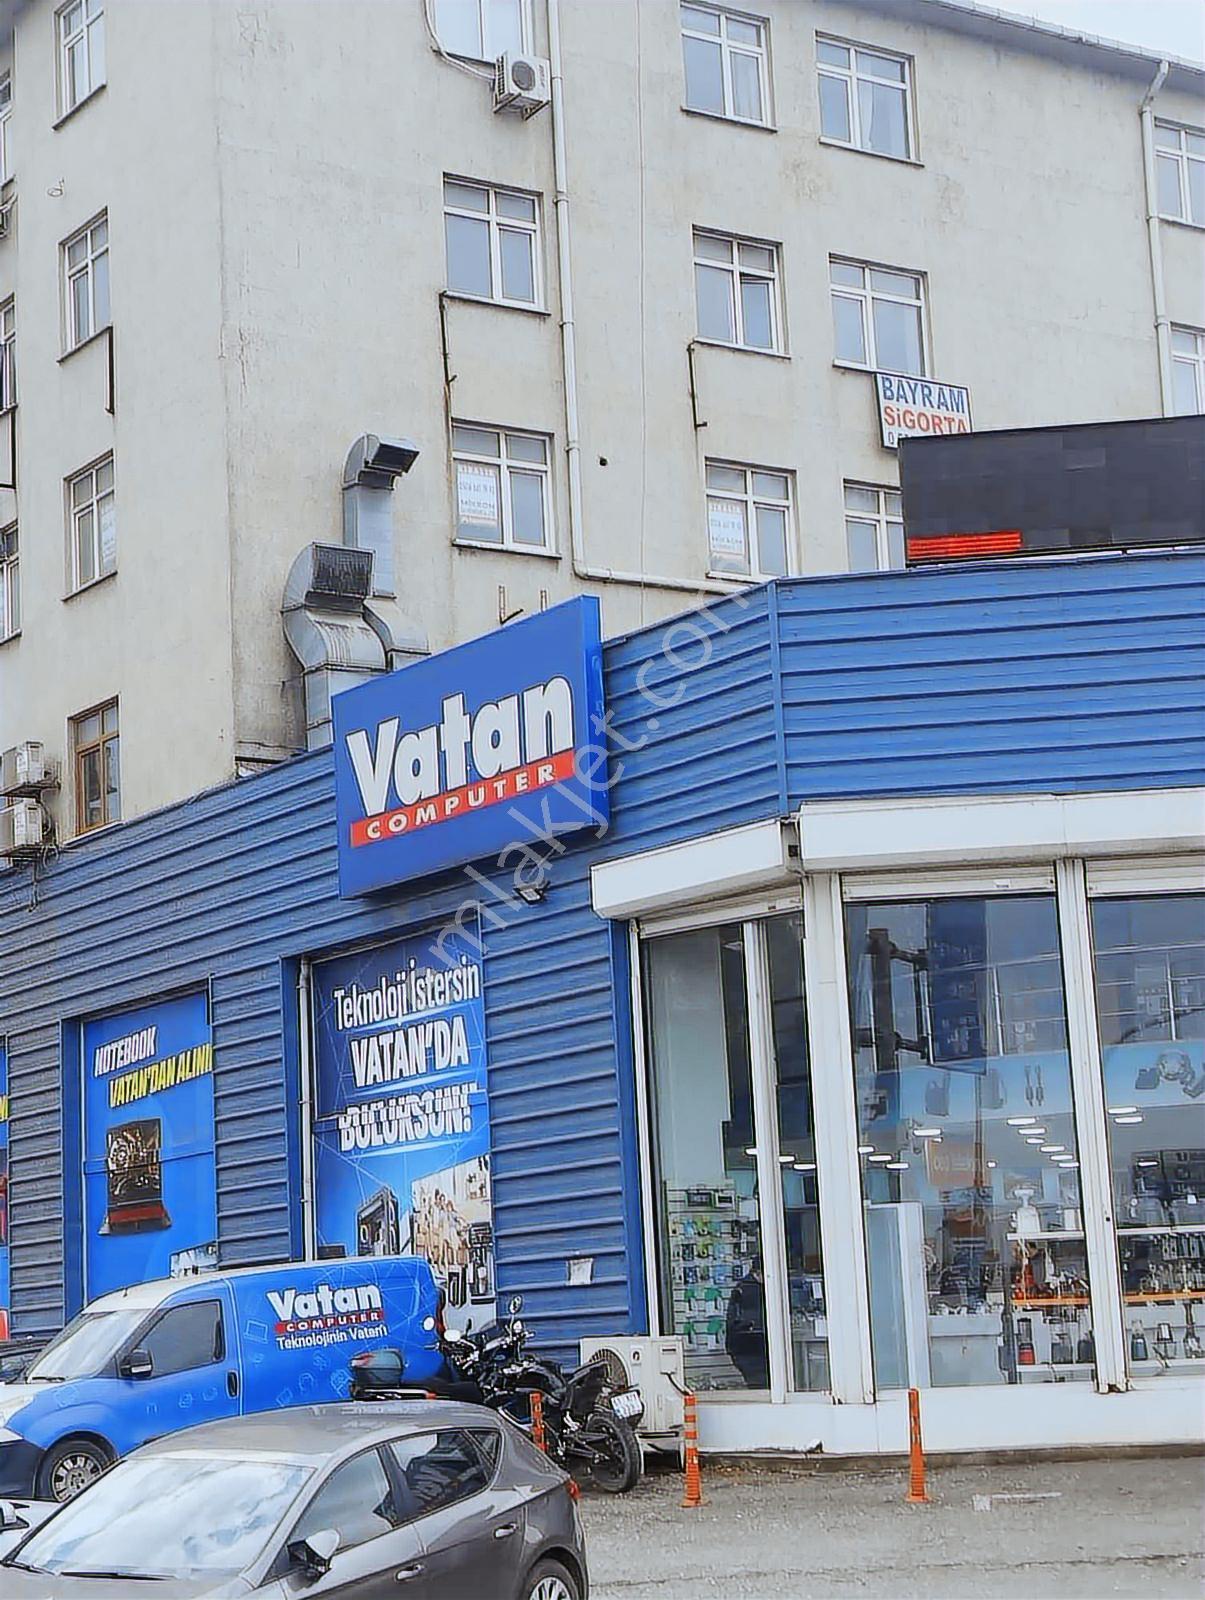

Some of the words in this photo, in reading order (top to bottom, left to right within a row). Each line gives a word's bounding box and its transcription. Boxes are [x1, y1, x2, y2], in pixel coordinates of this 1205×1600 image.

[881, 376, 965, 413] BAYRAM
[346, 676, 575, 817] Vatan
[366, 764, 555, 840] COMPUTER
[334, 971, 407, 1031] Teknoloji
[94, 1026, 157, 1078] NOTEBOOK
[110, 1056, 176, 1108] VATAN'DAN
[176, 1043, 213, 1083] ALINI
[351, 1015, 469, 1087] VATAN'DA
[266, 1284, 382, 1321] Vatan
[286, 1312, 379, 1332] COMPUTER
[277, 1331, 347, 1350] Teknolojinin
